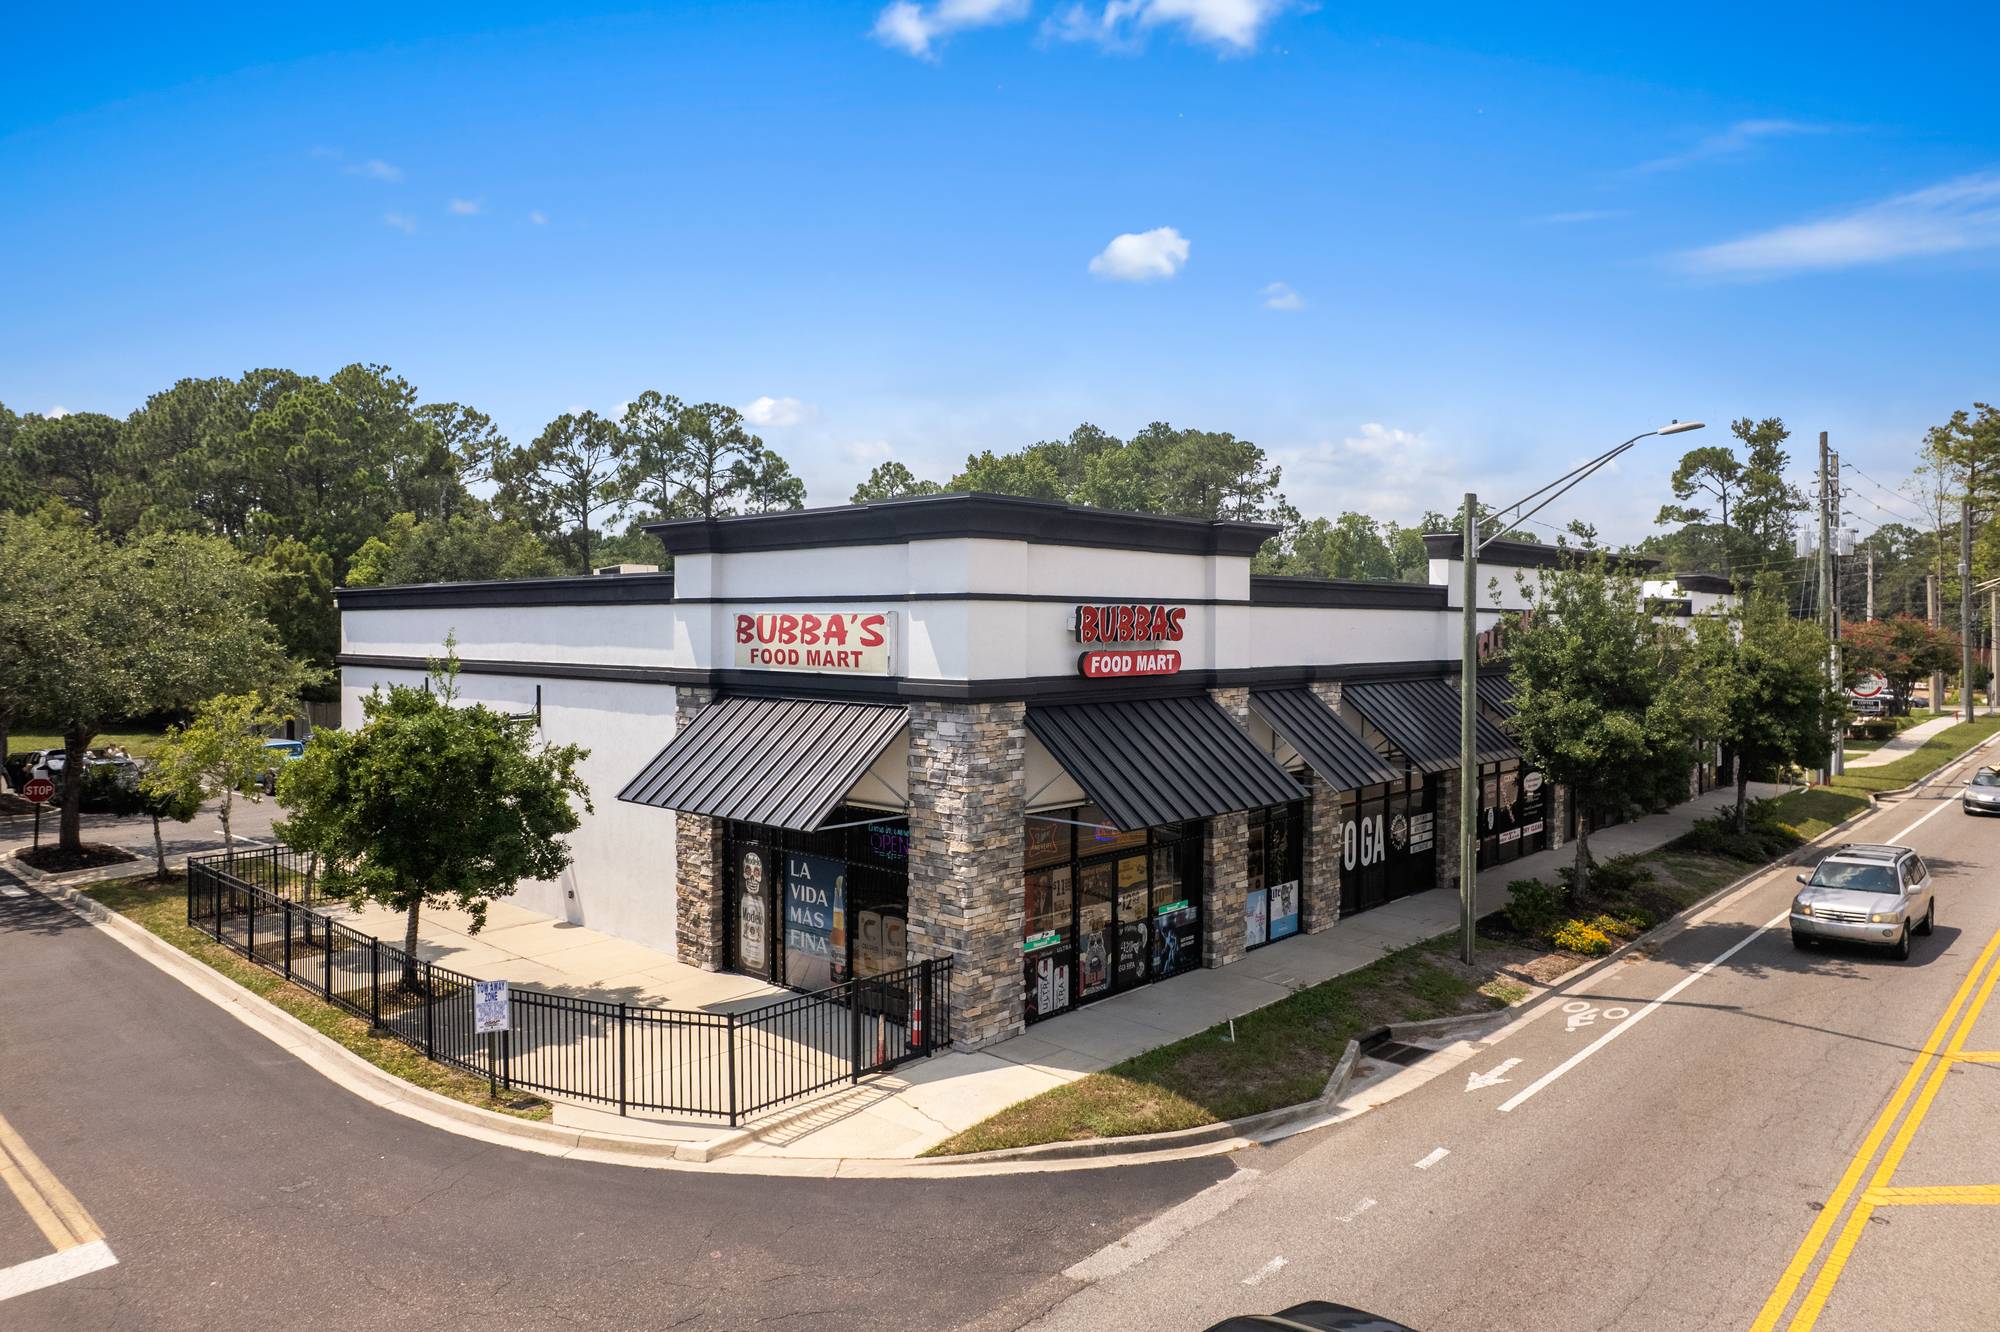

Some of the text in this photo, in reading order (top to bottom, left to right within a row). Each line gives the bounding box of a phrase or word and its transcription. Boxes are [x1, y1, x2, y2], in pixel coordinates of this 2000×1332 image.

[736, 614, 885, 647] BUBBA'S
[751, 648, 863, 668] FOOD MART
[1091, 654, 1175, 673] FOOD MART
[26, 785, 53, 796] STOP
[870, 833, 909, 853] OPEN
[791, 859, 811, 880] LA
[790, 883, 828, 907] VIDA
[742, 907, 764, 925] Modelo
[791, 906, 825, 929] MÁS
[790, 929, 828, 954] FINA
[477, 981, 504, 993] TOW AWAY
[484, 991, 498, 1002] ZONE
